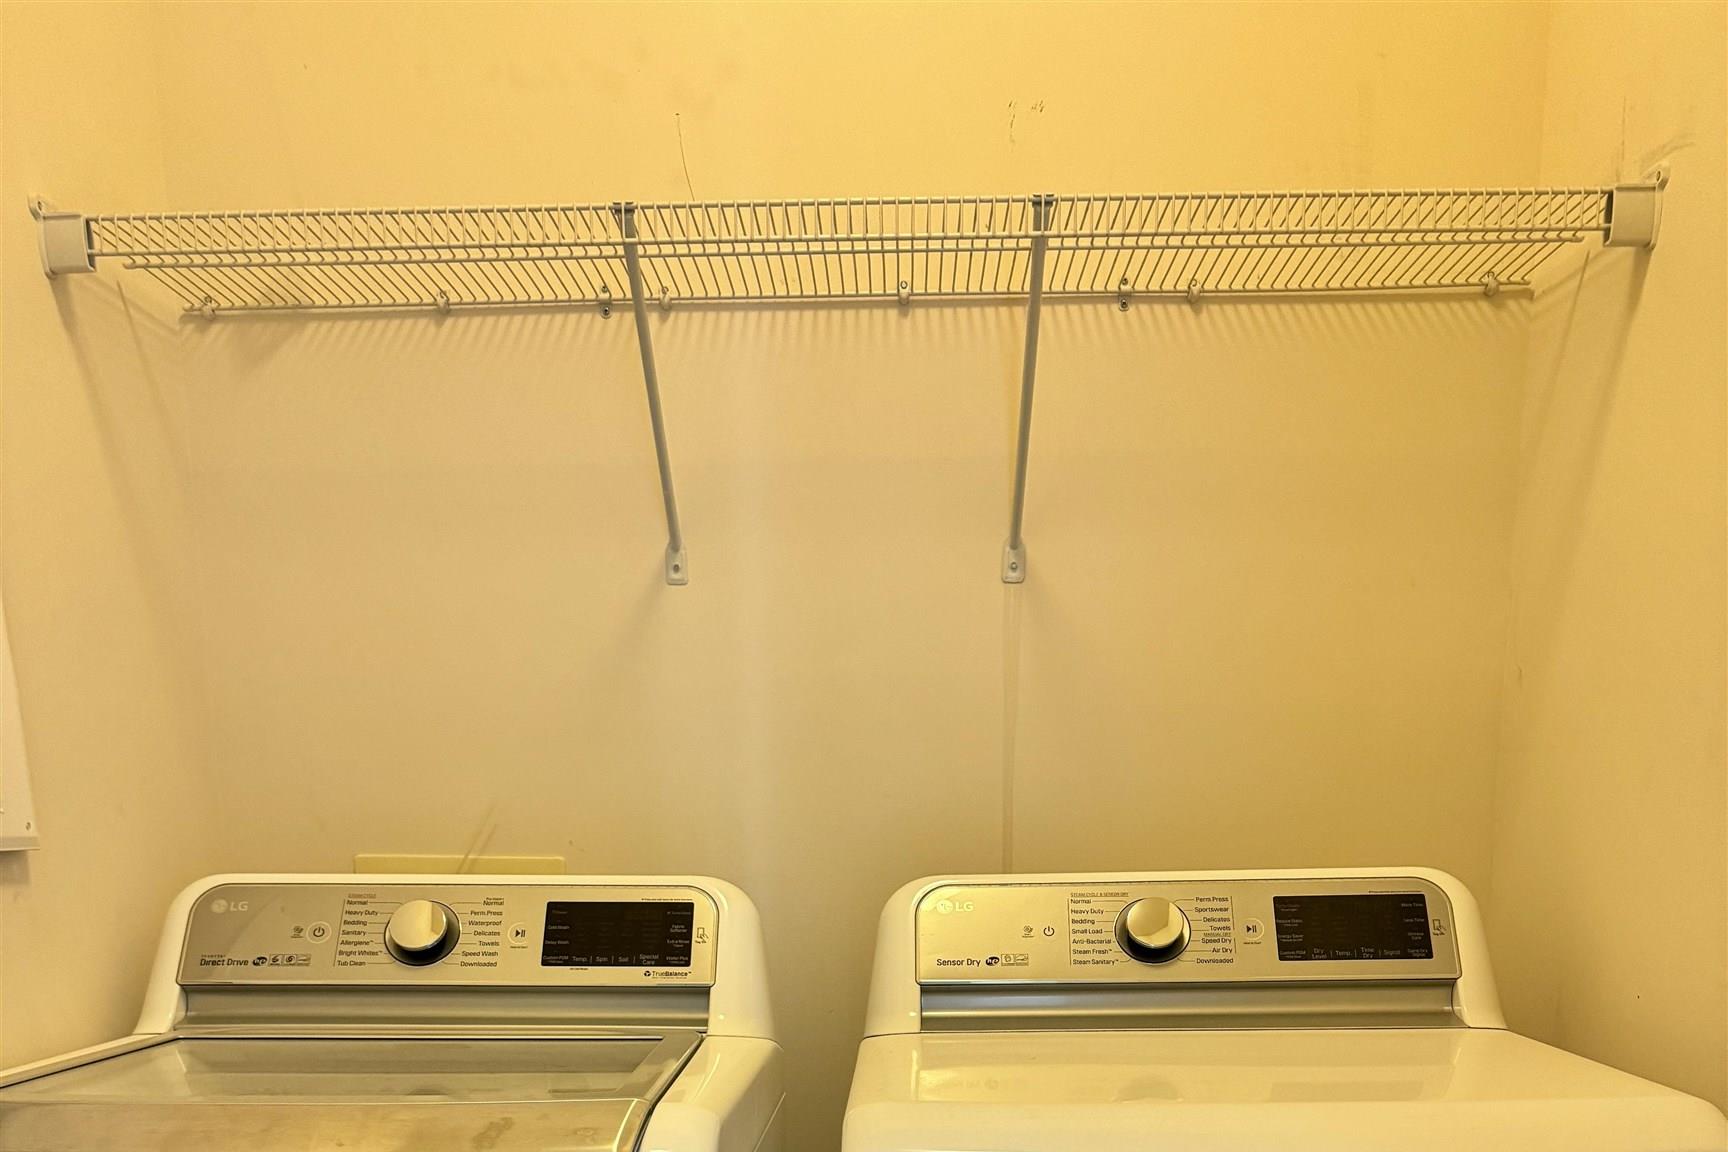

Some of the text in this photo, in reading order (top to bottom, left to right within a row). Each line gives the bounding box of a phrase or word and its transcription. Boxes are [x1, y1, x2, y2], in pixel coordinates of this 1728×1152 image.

[230, 901, 248, 912] LG
[956, 901, 973, 911] LG
[200, 958, 249, 967] Direct Drive
[937, 958, 981, 967] Sensor Dry
